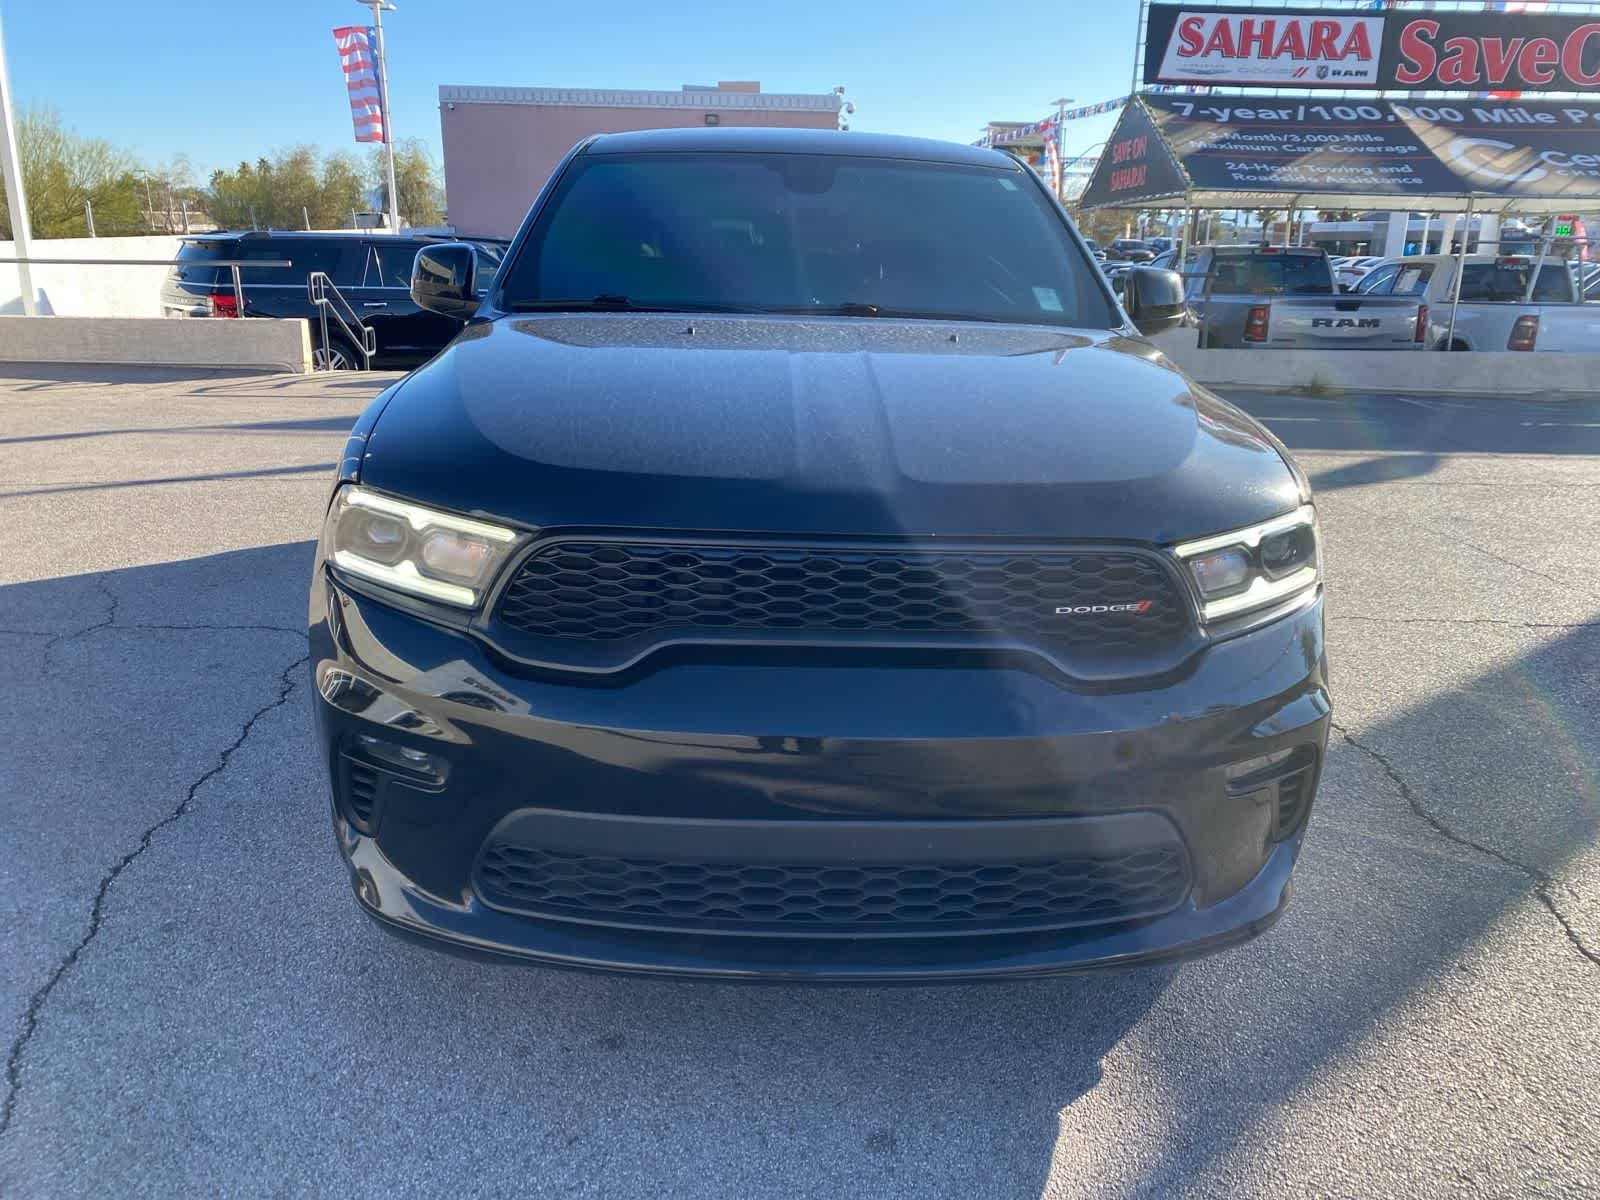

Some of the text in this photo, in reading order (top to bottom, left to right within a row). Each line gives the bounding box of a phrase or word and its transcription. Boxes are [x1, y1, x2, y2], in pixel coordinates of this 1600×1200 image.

[1177, 16, 1373, 60] SAHARA
[1472, 107, 1559, 124] Mile
[1112, 135, 1147, 164] SAVE ON
[1189, 140, 1419, 154] Maximum Care Coverage
[1302, 164, 1375, 175] Towing
[1377, 164, 1414, 174] and
[1231, 173, 1424, 185] Roadside Assistance
[1312, 318, 1380, 328] RAM
[1055, 603, 1141, 614] DODGE
